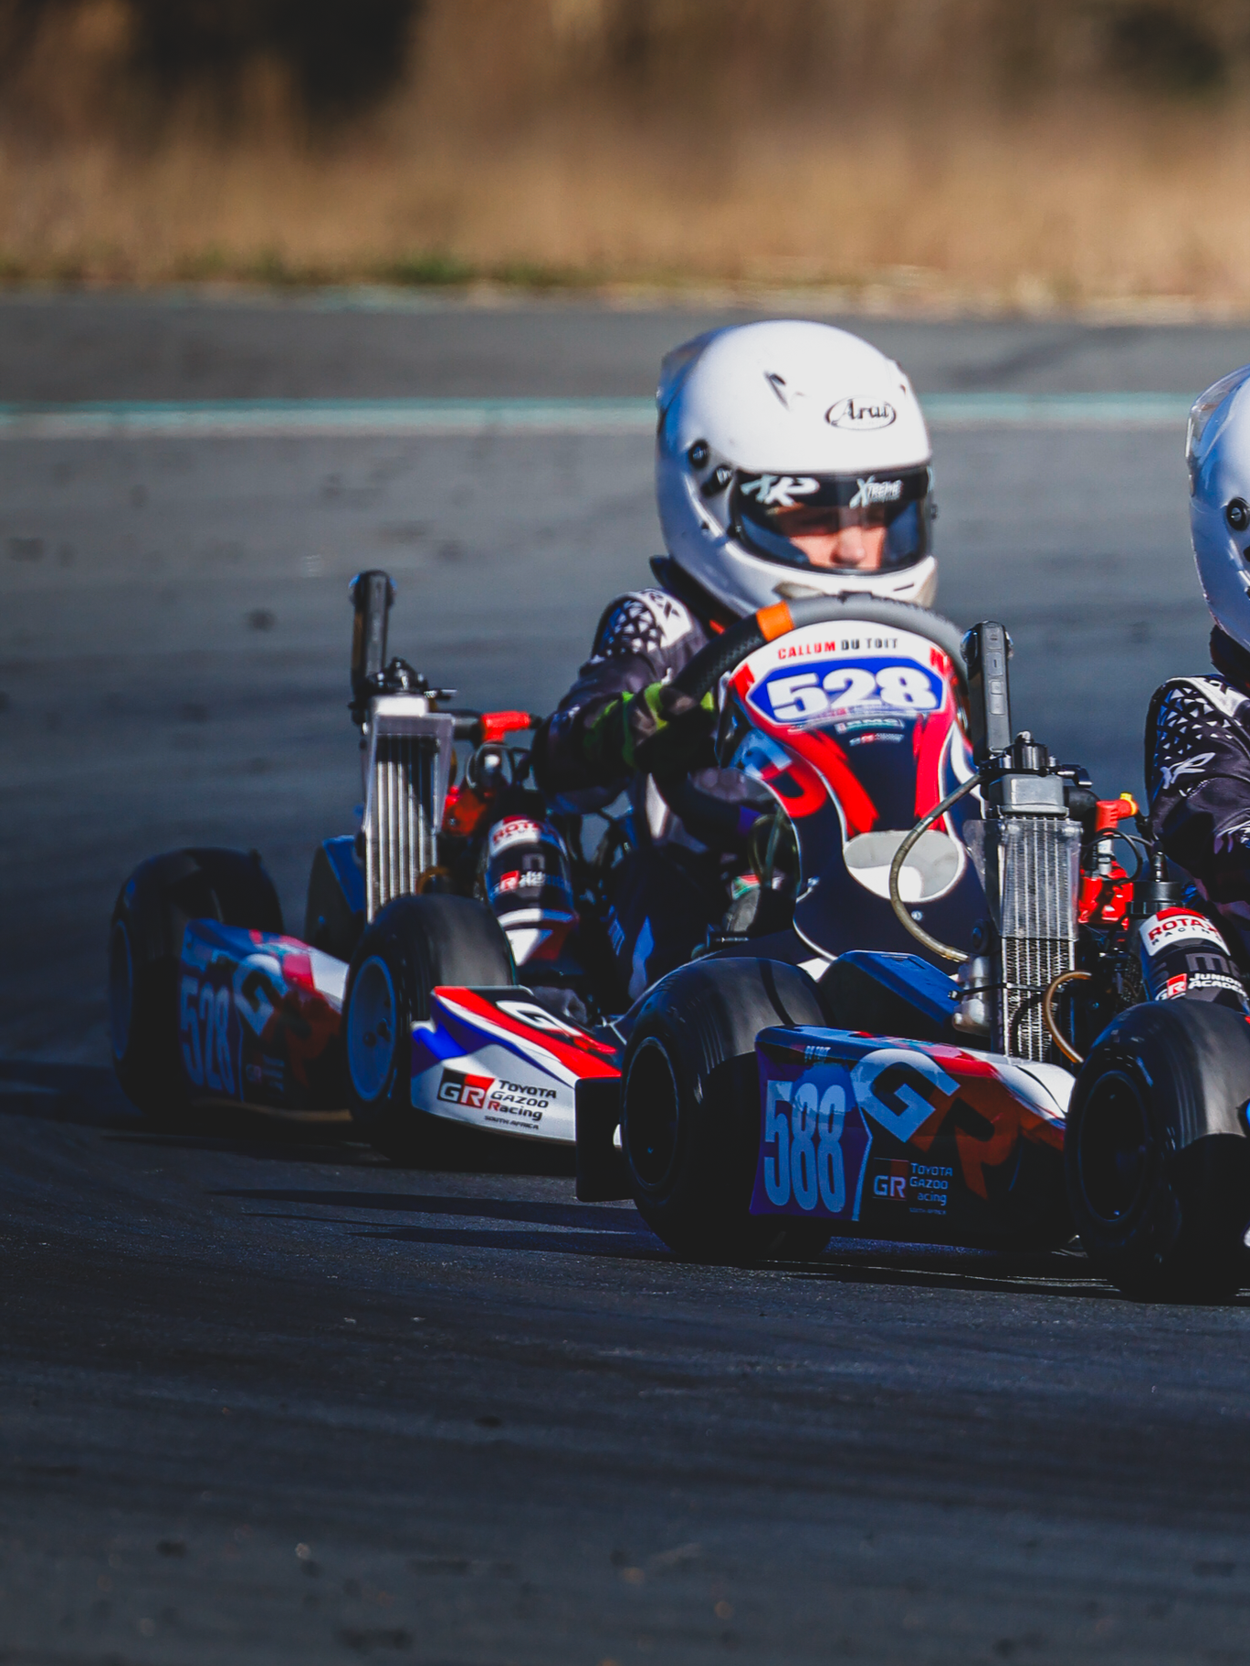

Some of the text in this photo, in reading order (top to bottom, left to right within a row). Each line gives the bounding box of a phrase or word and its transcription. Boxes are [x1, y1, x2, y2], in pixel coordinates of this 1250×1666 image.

[831, 398, 893, 427] Arai
[778, 638, 898, 660] CALLUM DU TOIT
[766, 666, 938, 720] 528
[1148, 918, 1218, 941] ROTAX
[180, 974, 235, 1095] 528
[490, 1090, 549, 1108] GAZOO
[499, 1080, 557, 1099] TOYOTA
[487, 1099, 543, 1121] Racing
[484, 1115, 539, 1130] SOUTH AFRICA
[764, 1079, 846, 1213] 588
[910, 1162, 953, 1177] TOYOTA
[873, 1174, 906, 1198] GR
[909, 1176, 949, 1190] GAZOO
[910, 1189, 948, 1207] acing
